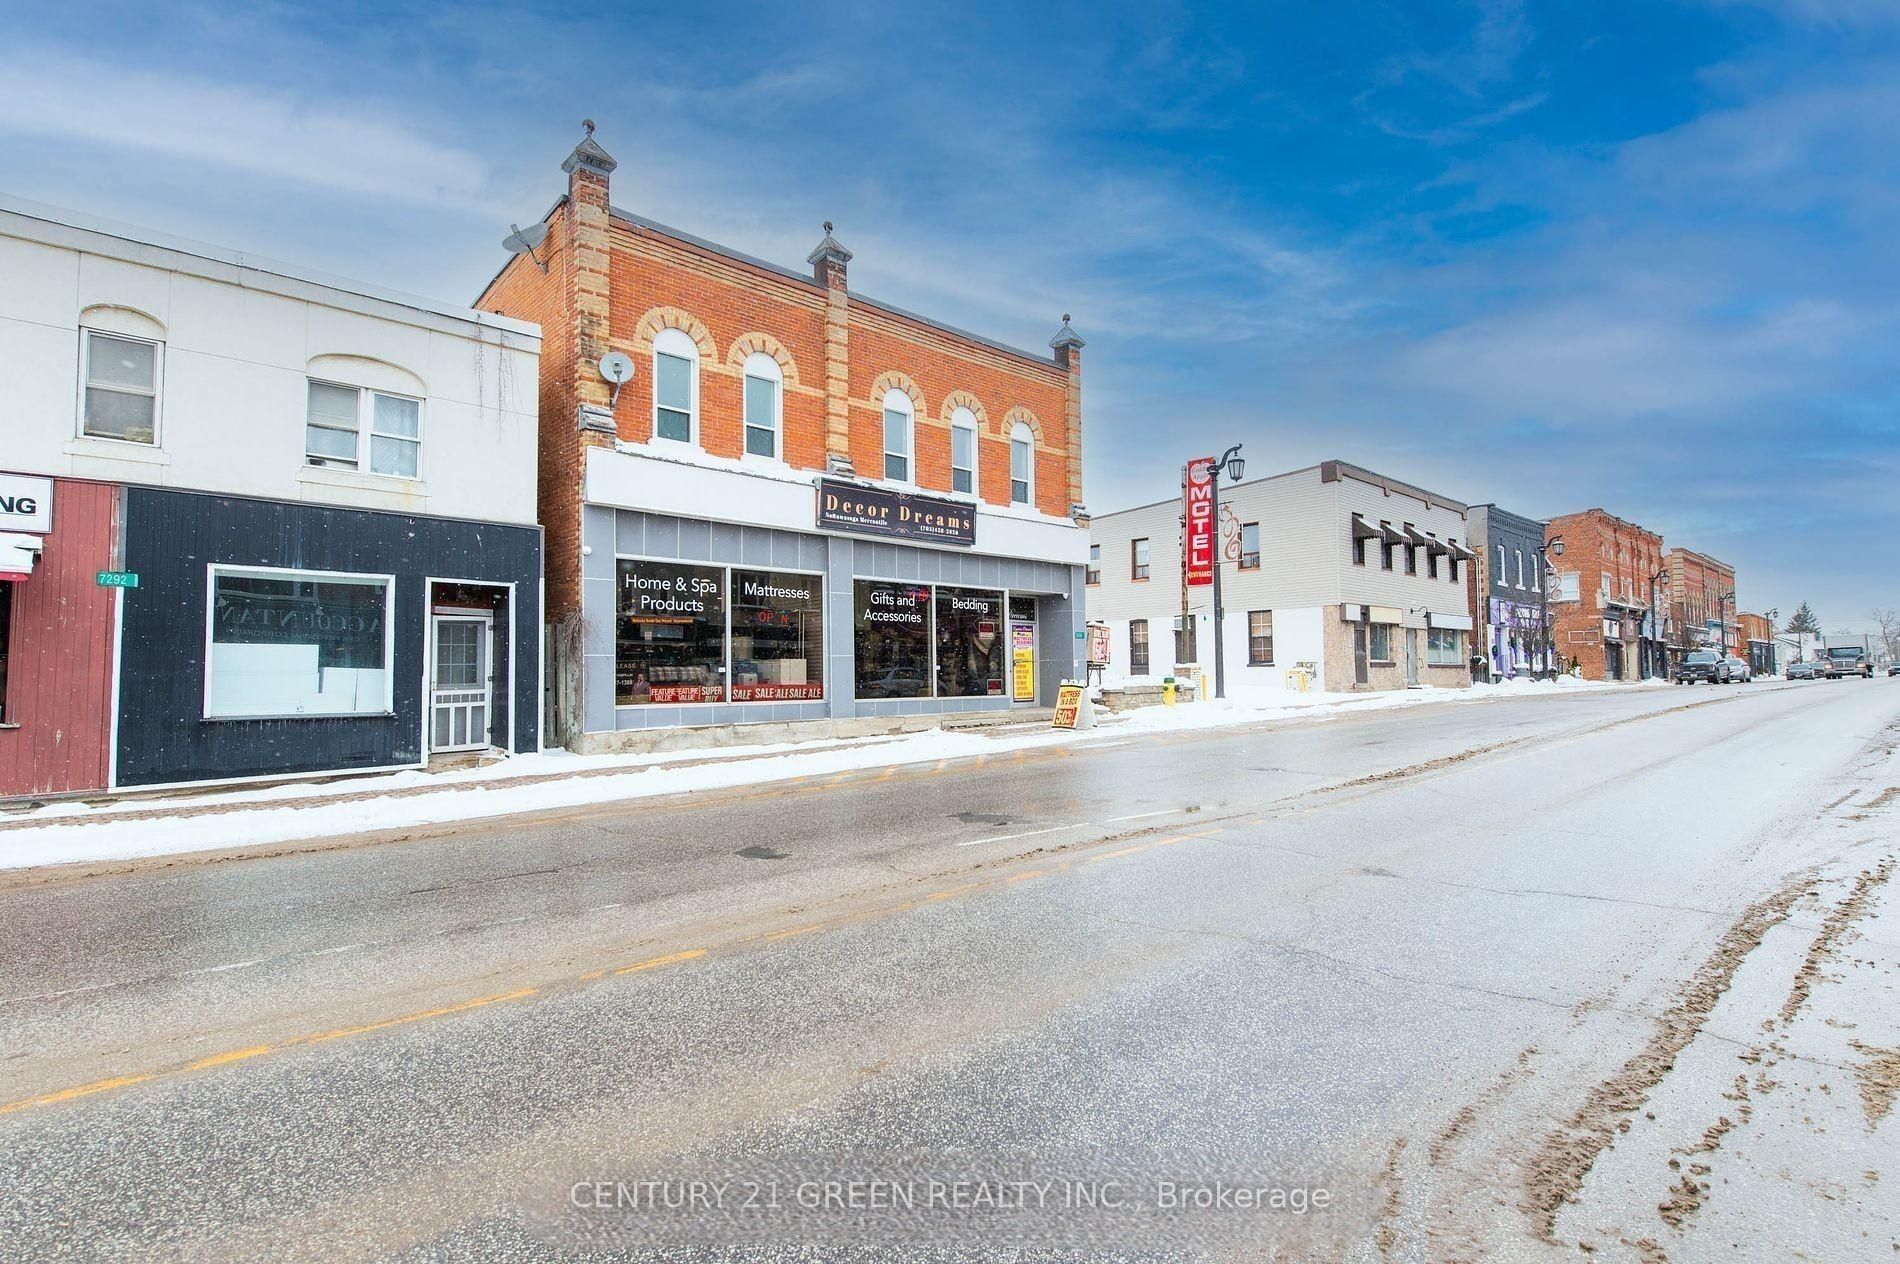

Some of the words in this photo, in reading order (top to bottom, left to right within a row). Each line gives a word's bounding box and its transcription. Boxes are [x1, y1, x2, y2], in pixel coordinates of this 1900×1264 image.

[0, 496, 37, 514] NG
[826, 494, 888, 518] Decor
[899, 505, 970, 530] Dreams
[1190, 485, 1211, 566] MOTEL
[99, 574, 127, 585] 7292
[625, 573, 671, 590] Home
[675, 577, 687, 592] &
[691, 578, 717, 598] Spa
[744, 582, 810, 600] Mattresses
[641, 595, 704, 612] Products
[870, 592, 895, 606] Gifts
[897, 593, 916, 607] and
[952, 598, 989, 613] Bedding
[758, 611, 788, 625] OPN
[863, 609, 922, 623] Accessories
[651, 688, 677, 696] FEATURE
[701, 686, 722, 695] SUPER
[732, 689, 752, 700] SALE
[755, 688, 774, 699] SALE
[788, 687, 807, 698] SALE
[654, 694, 672, 702] VALUE
[677, 694, 695, 702] VALUE
